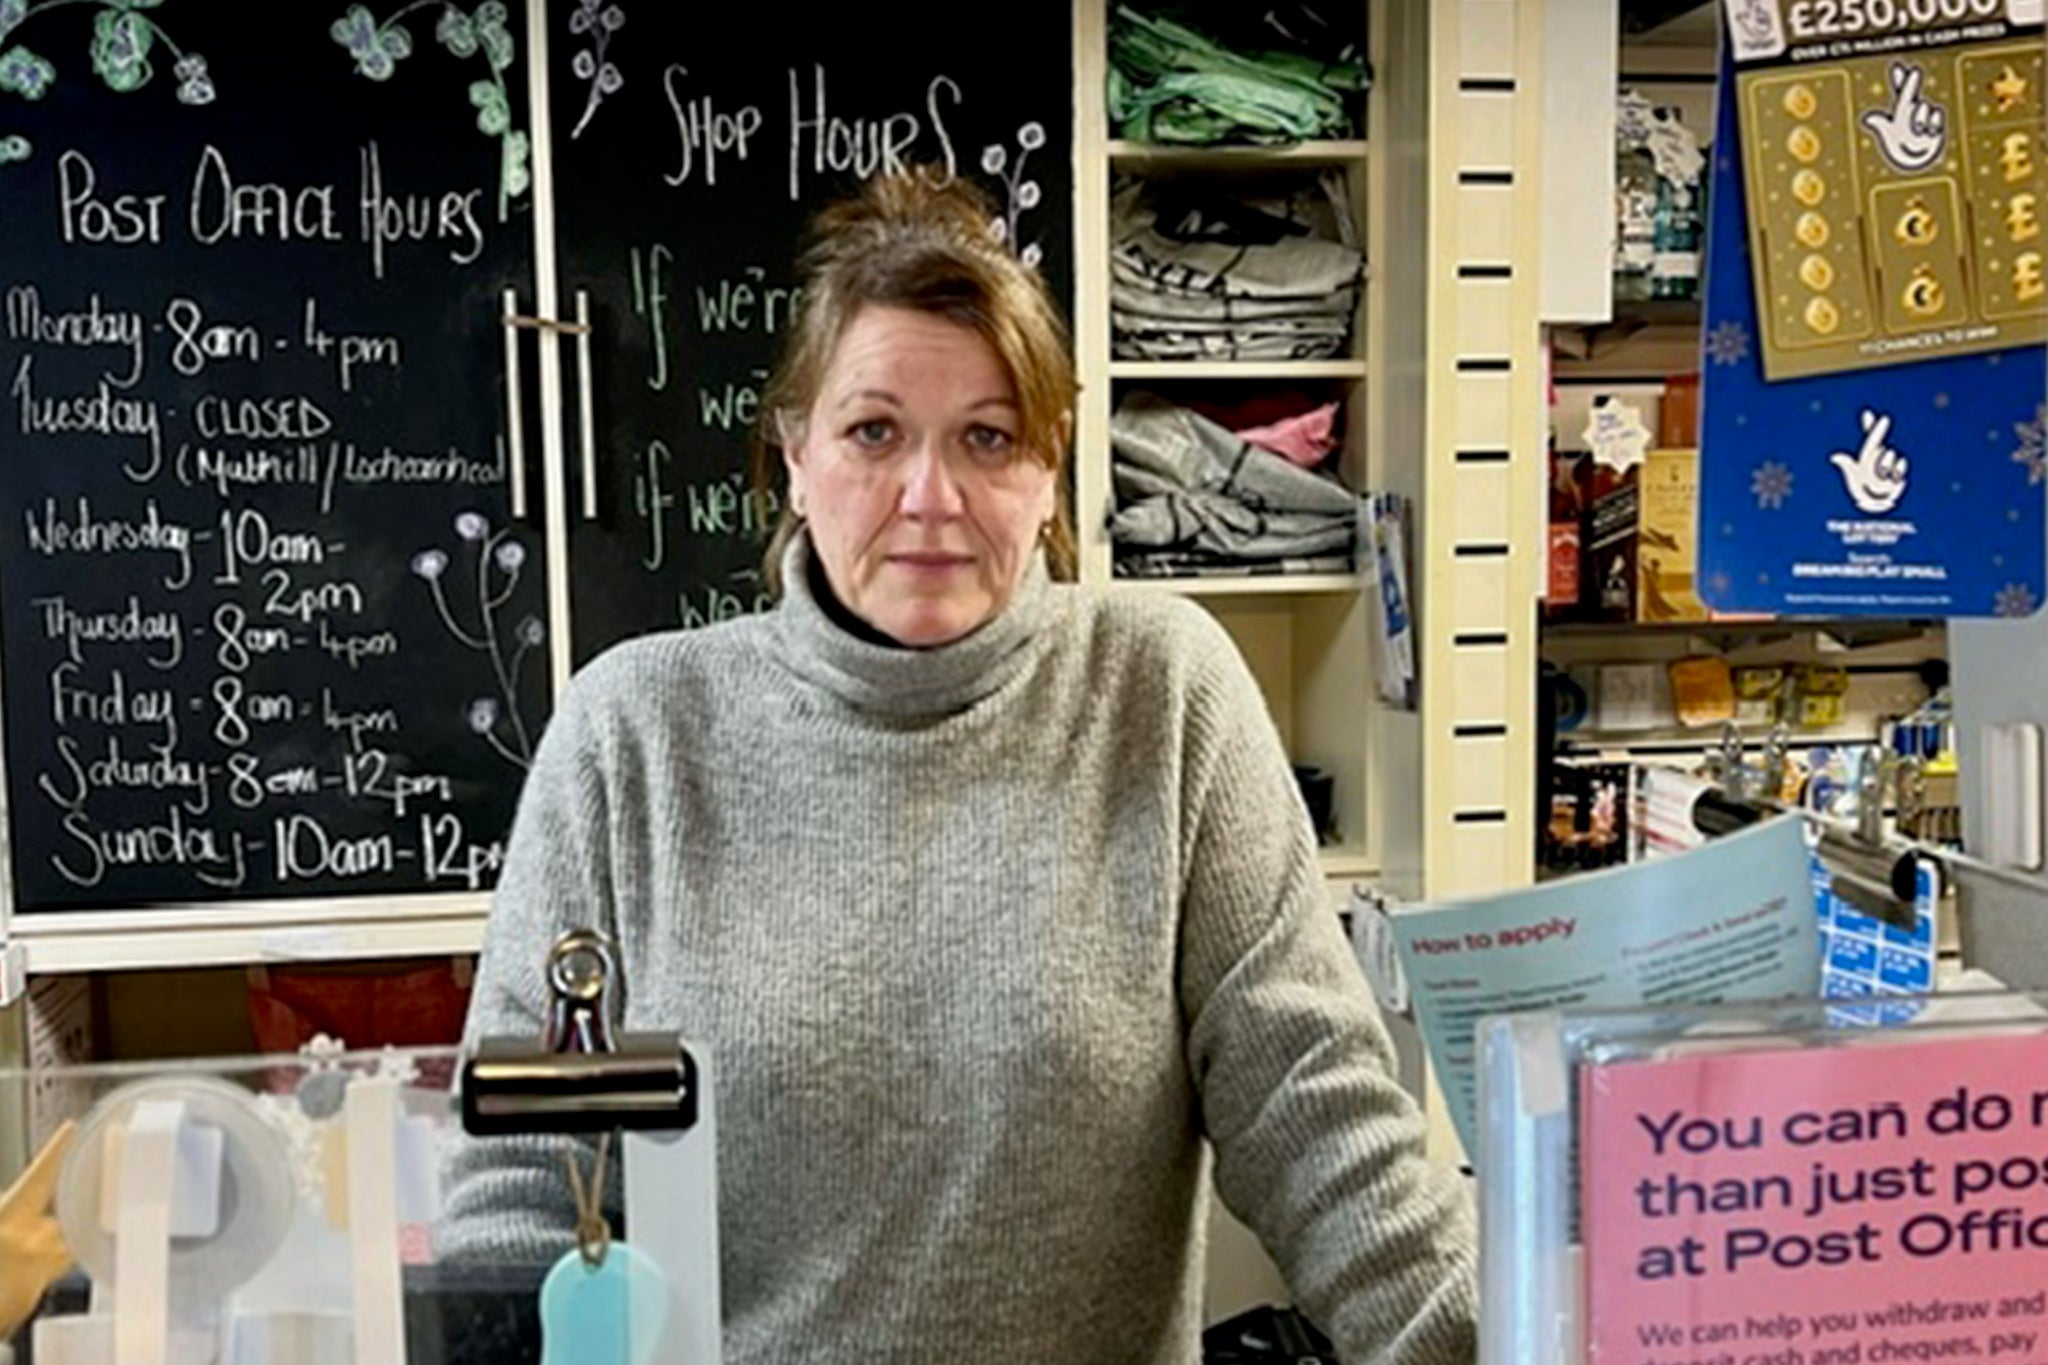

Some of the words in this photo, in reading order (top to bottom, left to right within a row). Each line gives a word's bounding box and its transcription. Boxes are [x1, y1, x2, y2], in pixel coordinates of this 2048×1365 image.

[6, 286, 142, 388] Monday
[630, 243, 674, 391] If
[12, 353, 161, 482] Tuesday
[196, 396, 332, 438] CLOSED
[25, 498, 192, 590] Wednesday
[261, 569, 363, 623] 2pm
[32, 597, 181, 669] Thursday
[51, 662, 177, 752] Friday
[39, 736, 210, 816] Saturday
[52, 805, 245, 888] Sunday
[1411, 937, 1461, 954] How
[1464, 932, 1493, 949] to
[1498, 916, 1577, 946] apply
[1636, 1111, 1763, 1156] You
[1782, 1102, 1907, 1146] can
[1926, 1088, 2013, 1134] do
[1636, 1173, 1793, 1219] than
[1806, 1156, 1936, 1215] just
[1636, 1237, 1706, 1281] at
[1726, 1222, 1882, 1273] Post
[1637, 1322, 1684, 1347] We
[1692, 1322, 1740, 1345] can
[1744, 1314, 1801, 1343] help
[1810, 1313, 1859, 1338] you
[1866, 1299, 1990, 1329] withdraw
[1997, 1291, 2046, 1317] and
[1745, 1347, 1802, 1365] cash
[1811, 1341, 1861, 1365] and
[1988, 1330, 2040, 1355] pay
